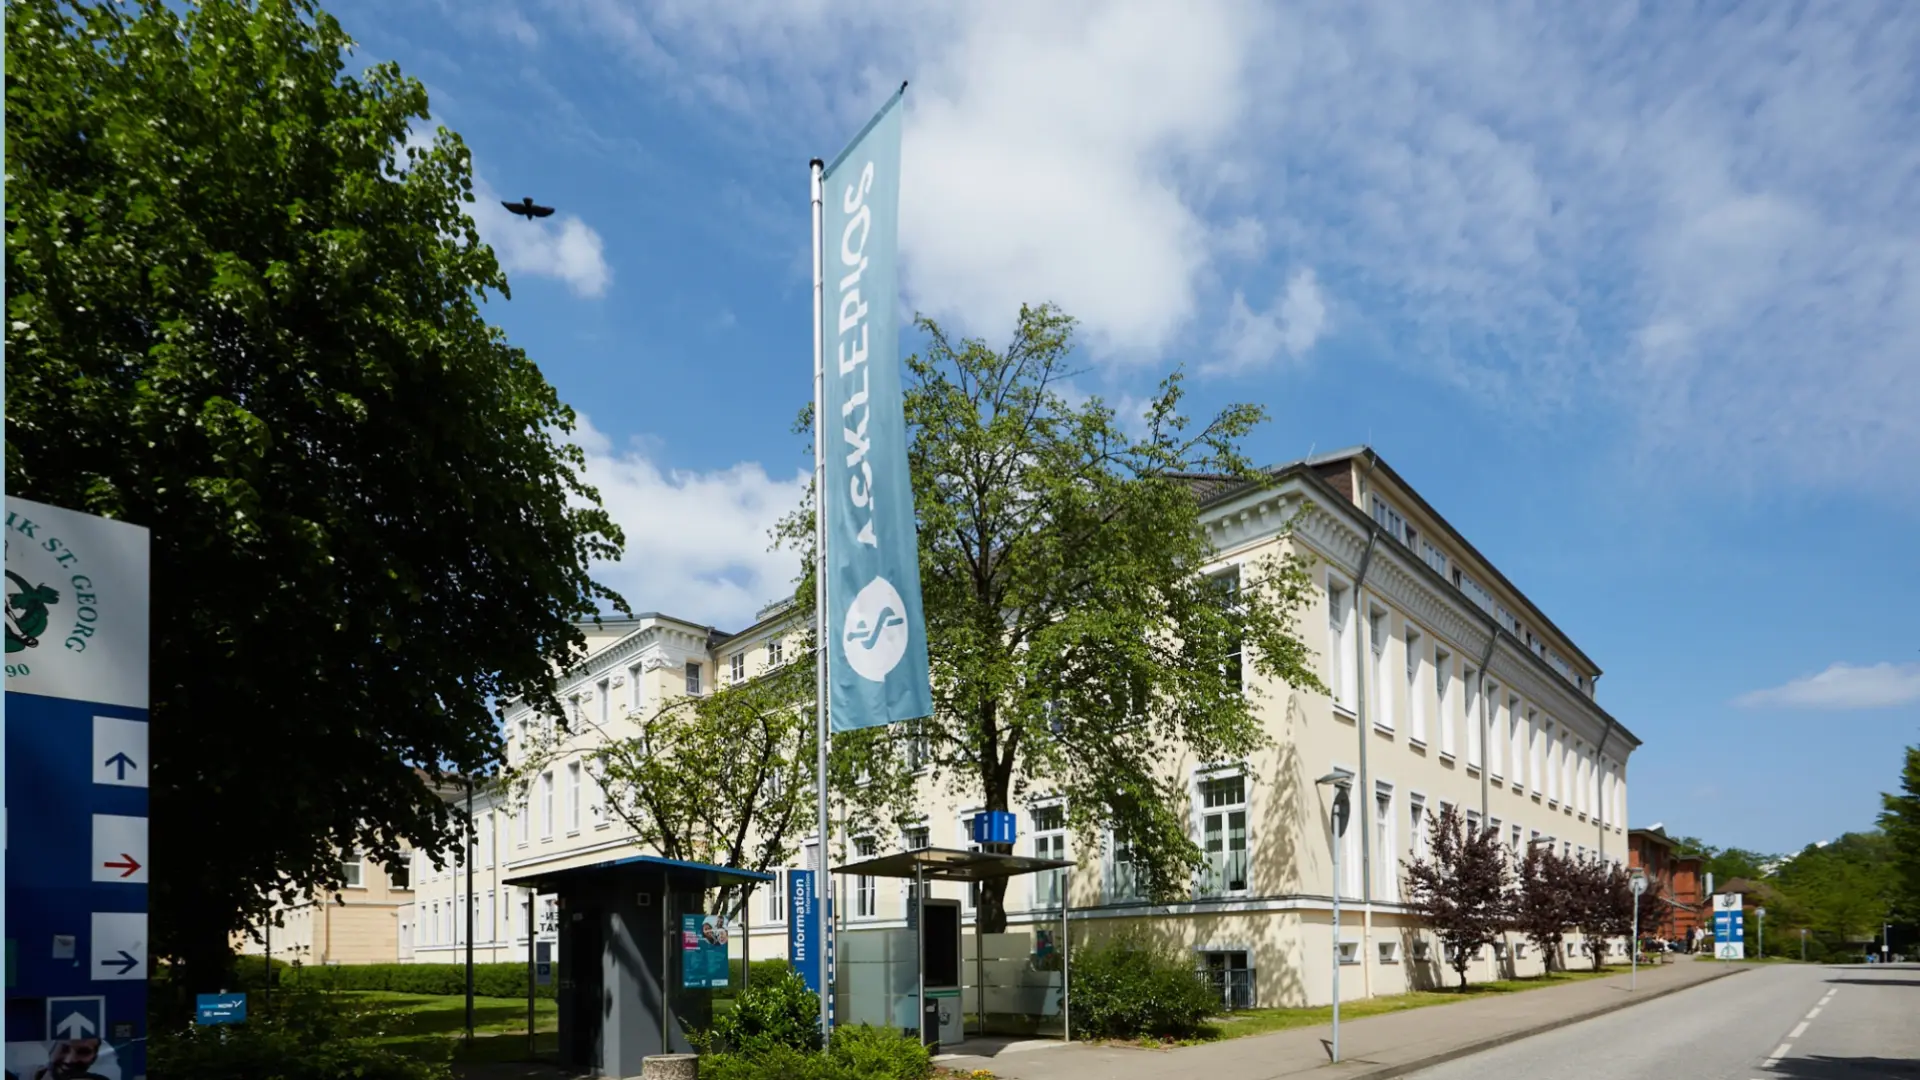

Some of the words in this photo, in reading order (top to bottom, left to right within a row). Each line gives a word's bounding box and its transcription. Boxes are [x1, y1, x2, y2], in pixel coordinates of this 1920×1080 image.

[838, 161, 878, 549] ASKLEPIOS
[41, 537, 79, 570] ST.
[64, 574, 99, 653] GEORG
[983, 815, 989, 840] i
[1003, 815, 1009, 840] i
[795, 878, 805, 961] Information
